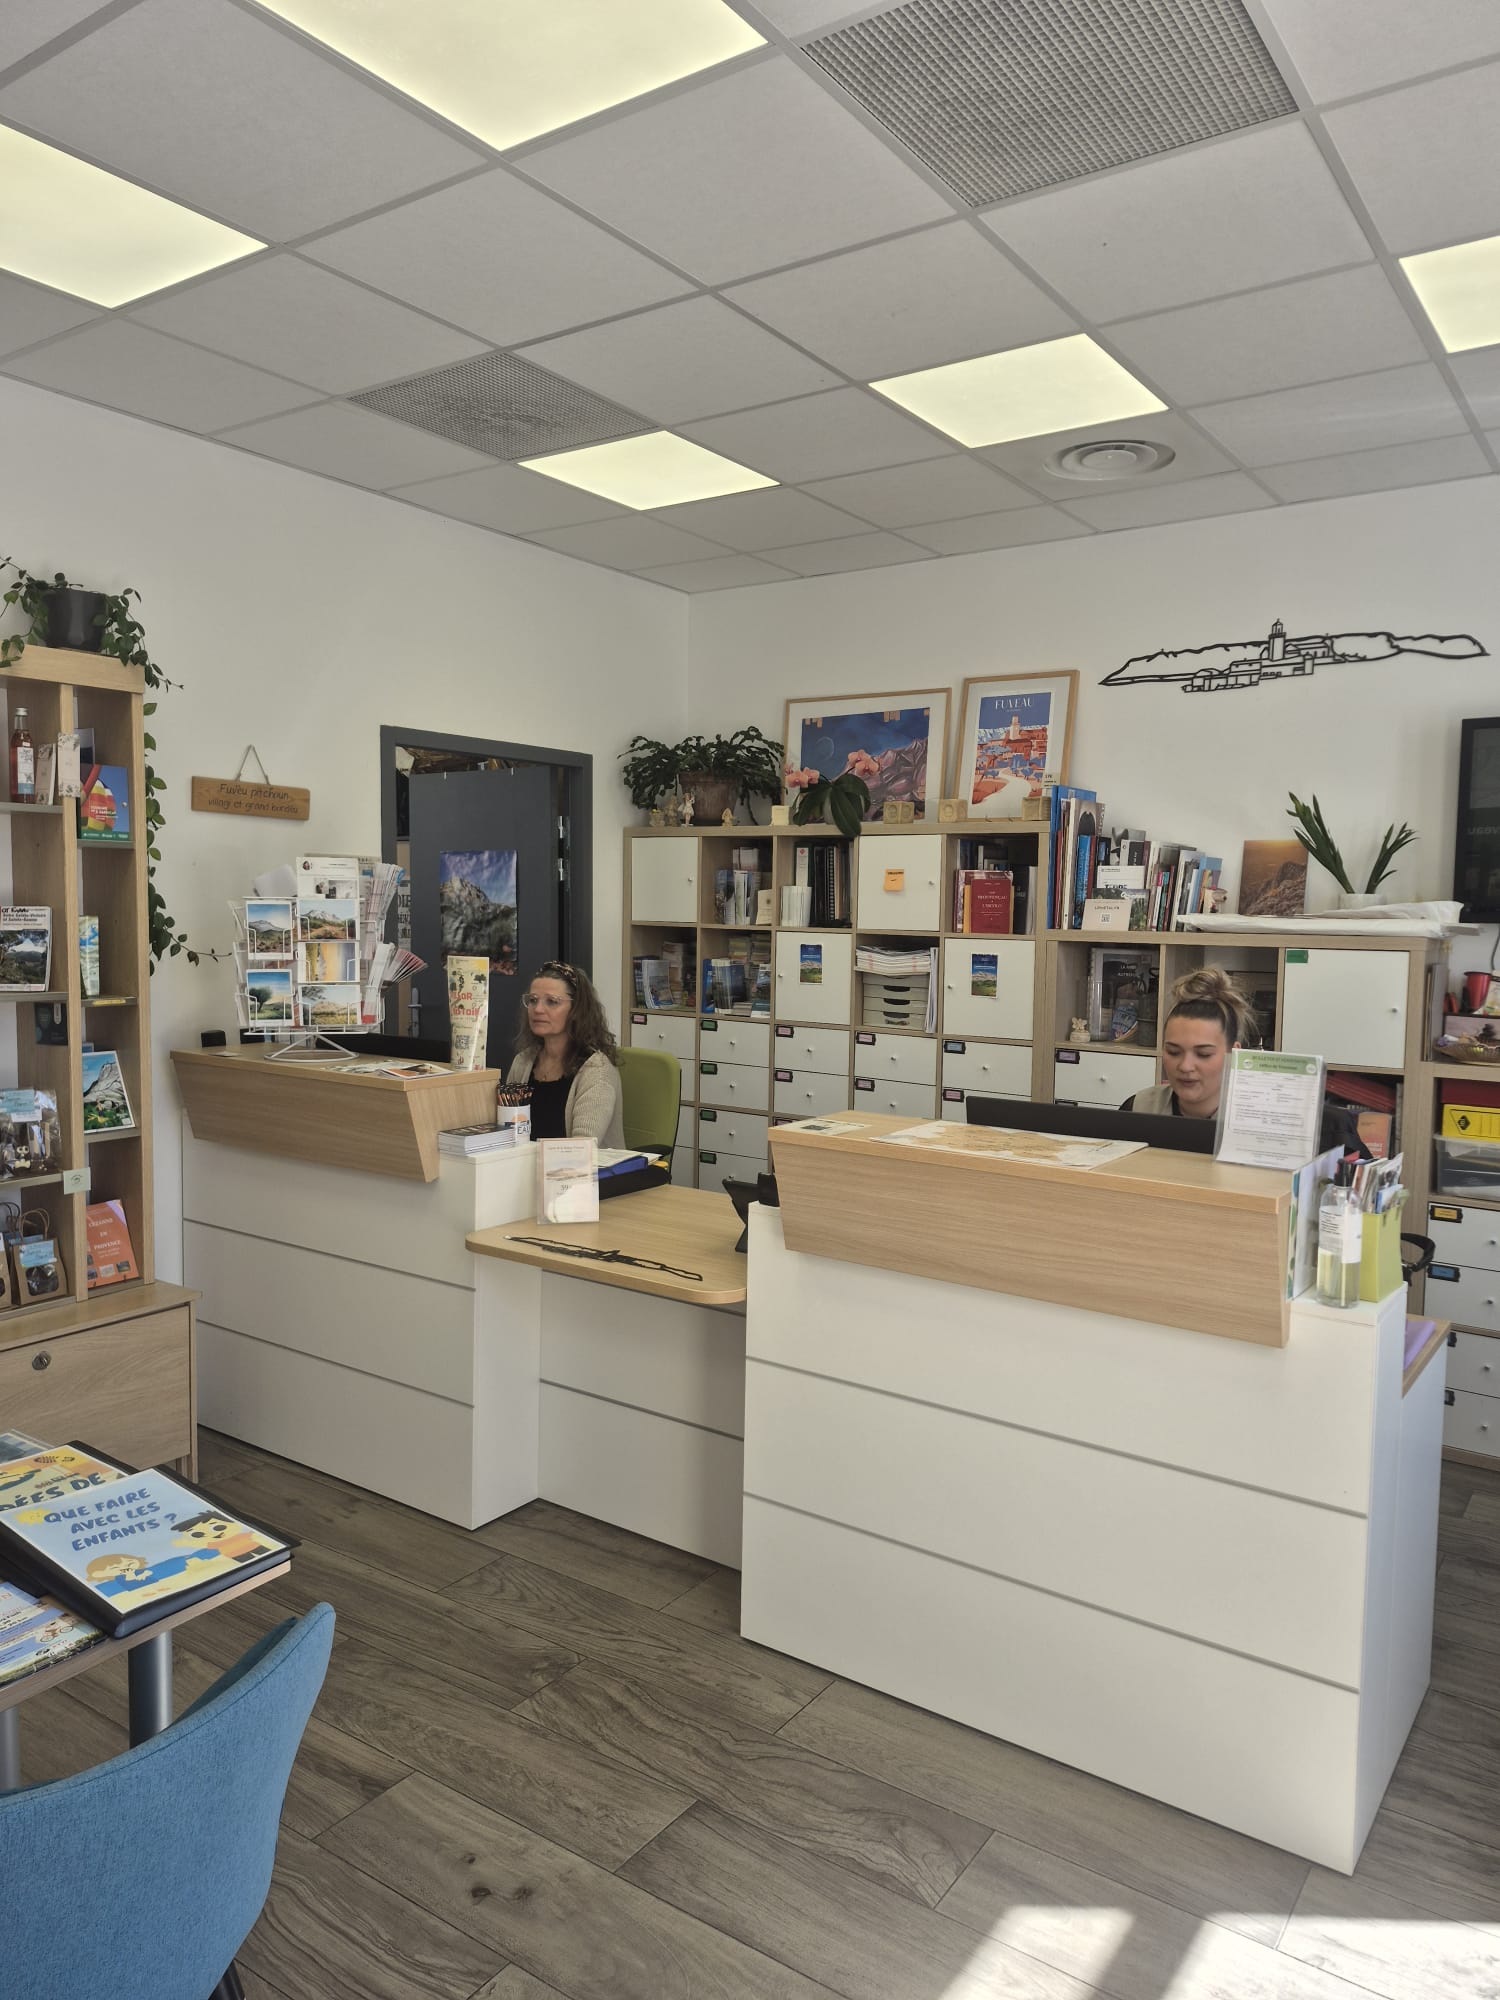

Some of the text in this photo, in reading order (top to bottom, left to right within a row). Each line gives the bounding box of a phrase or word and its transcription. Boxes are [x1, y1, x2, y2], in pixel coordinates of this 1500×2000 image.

[995, 698, 1032, 710] FUVEAU
[70, 1472, 106, 1491] DE
[43, 1488, 151, 1523] QUE FAIRE
[71, 1501, 161, 1534] AVEC LES
[71, 1512, 177, 1551] ENFANTS ?
